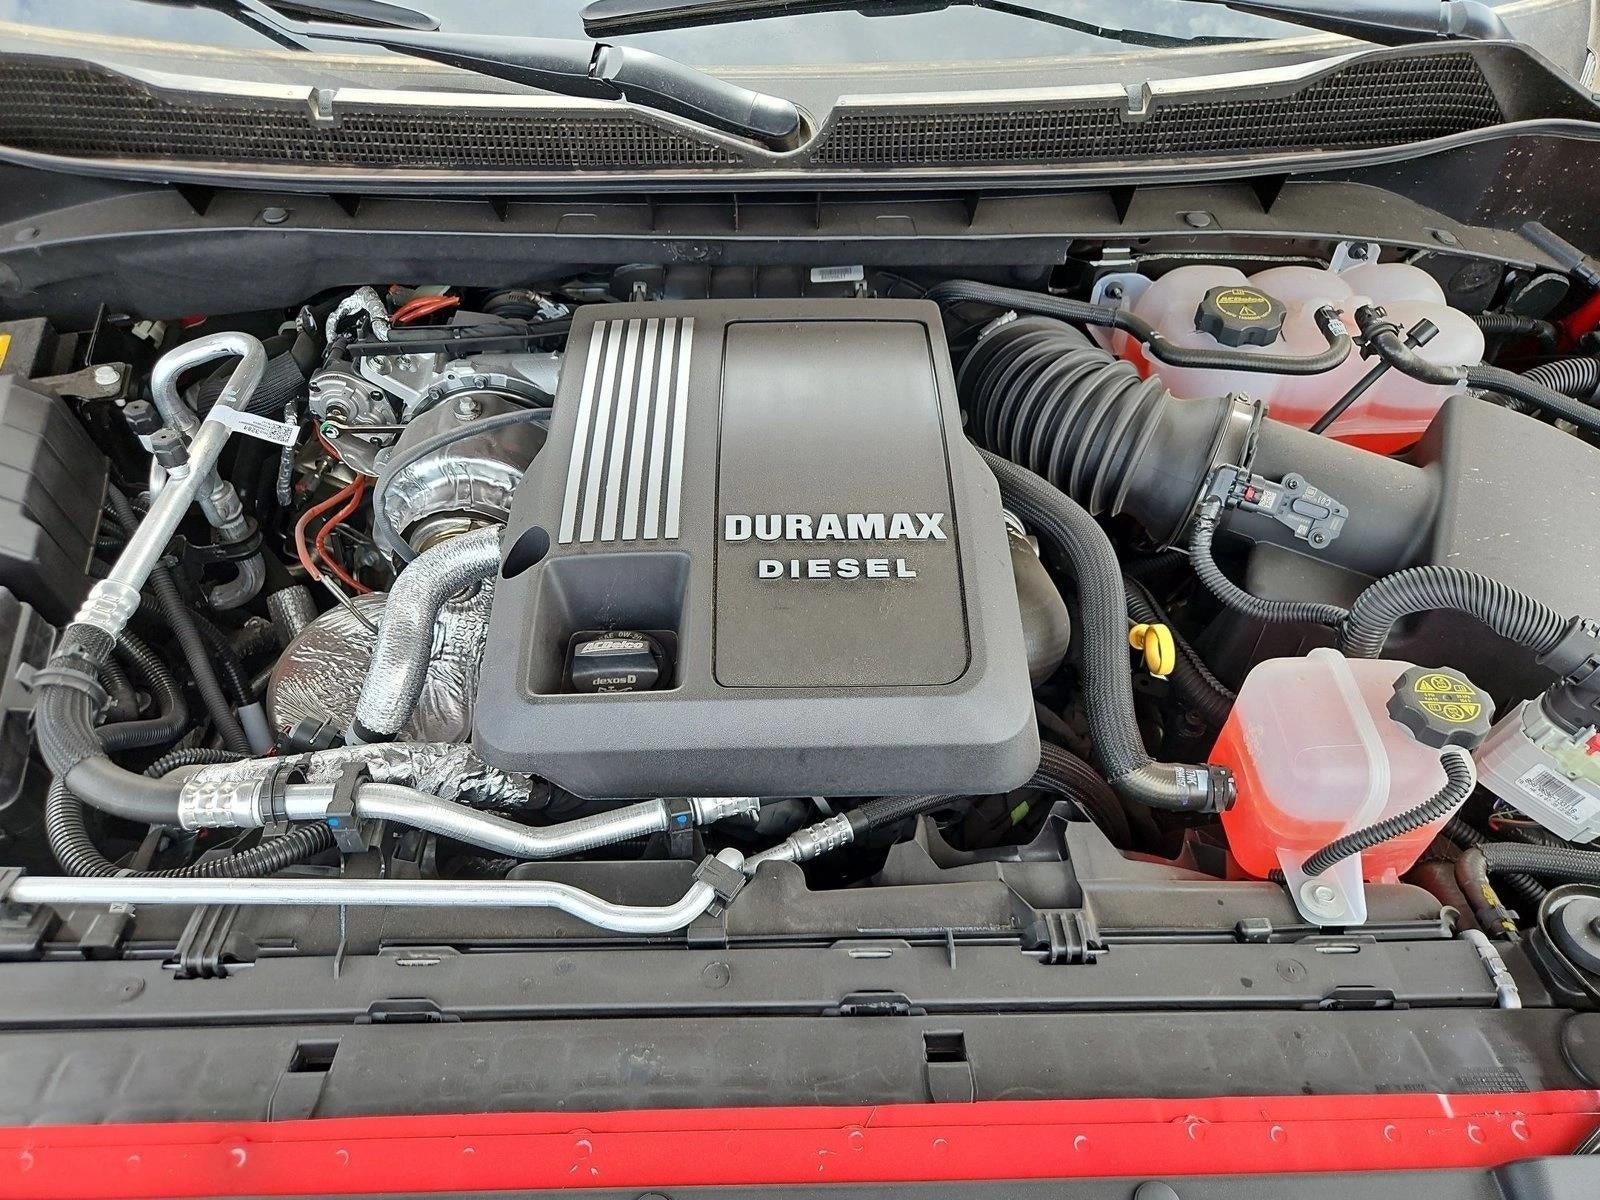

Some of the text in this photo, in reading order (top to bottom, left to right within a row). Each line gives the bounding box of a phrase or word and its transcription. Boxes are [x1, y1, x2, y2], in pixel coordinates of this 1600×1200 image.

[725, 513, 947, 541] DURAMAX
[758, 558, 917, 579] DIESEL
[581, 641, 643, 653] ACDelco
